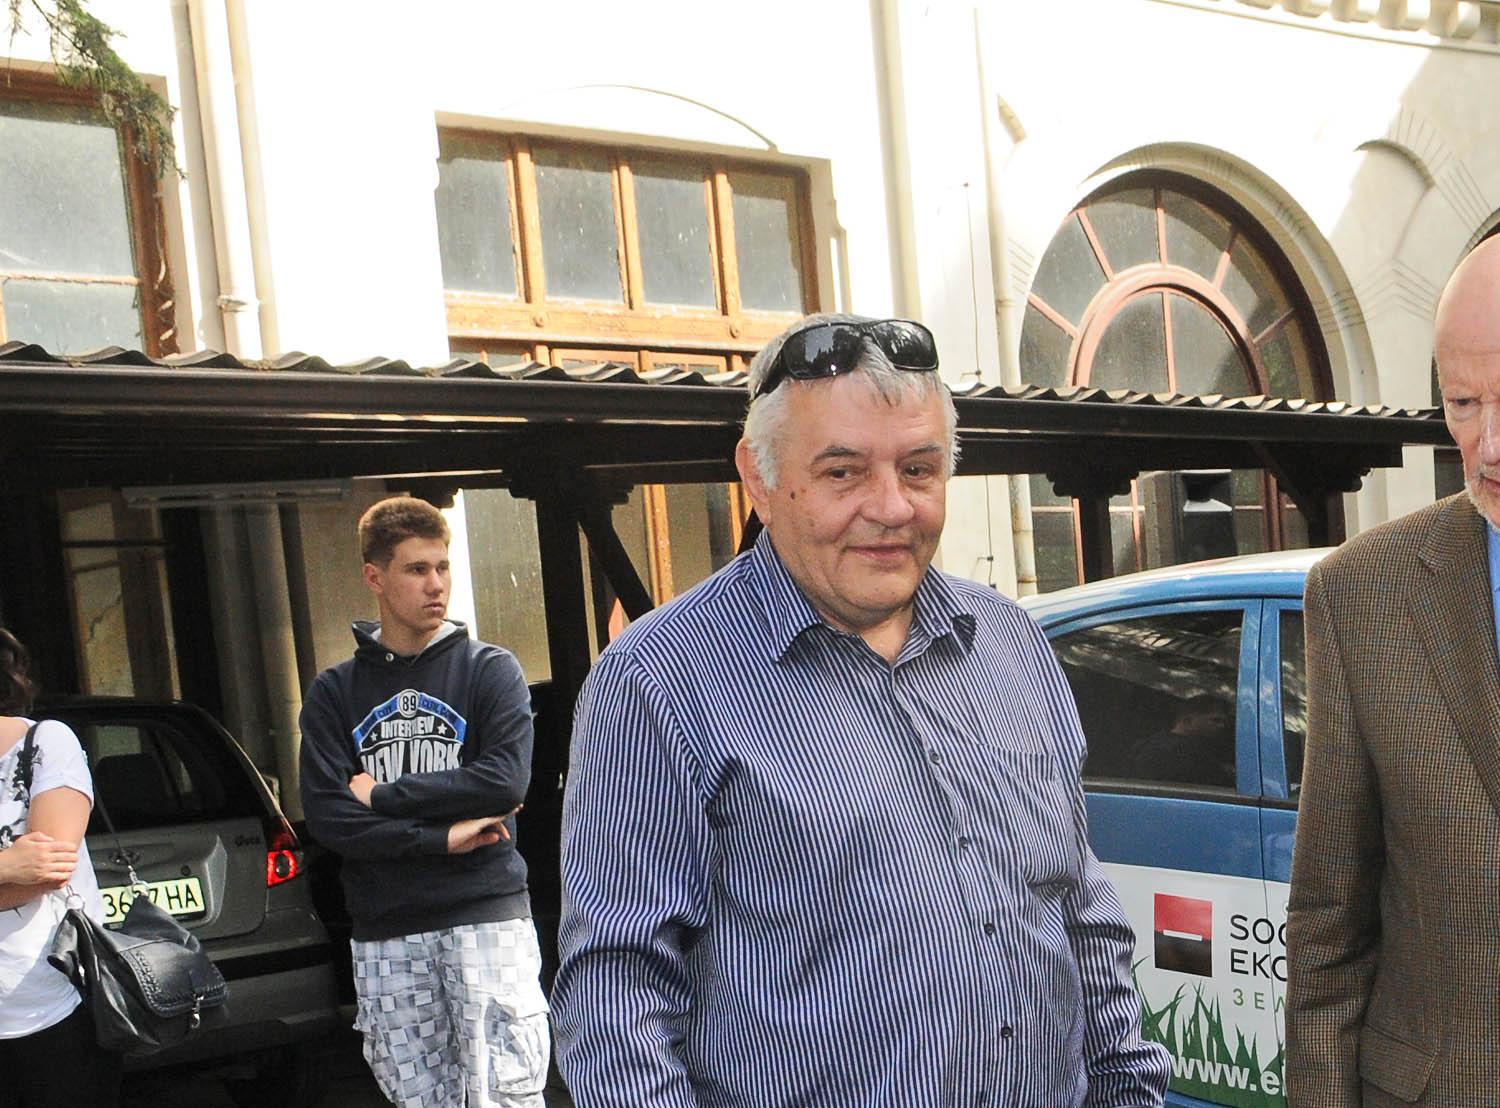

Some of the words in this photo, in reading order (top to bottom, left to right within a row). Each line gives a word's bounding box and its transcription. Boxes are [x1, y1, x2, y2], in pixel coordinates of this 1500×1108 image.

[402, 695, 417, 712] 89
[409, 739, 461, 774] YORK
[165, 884, 199, 910] HA
[1171, 1054, 1286, 1097] www.e
